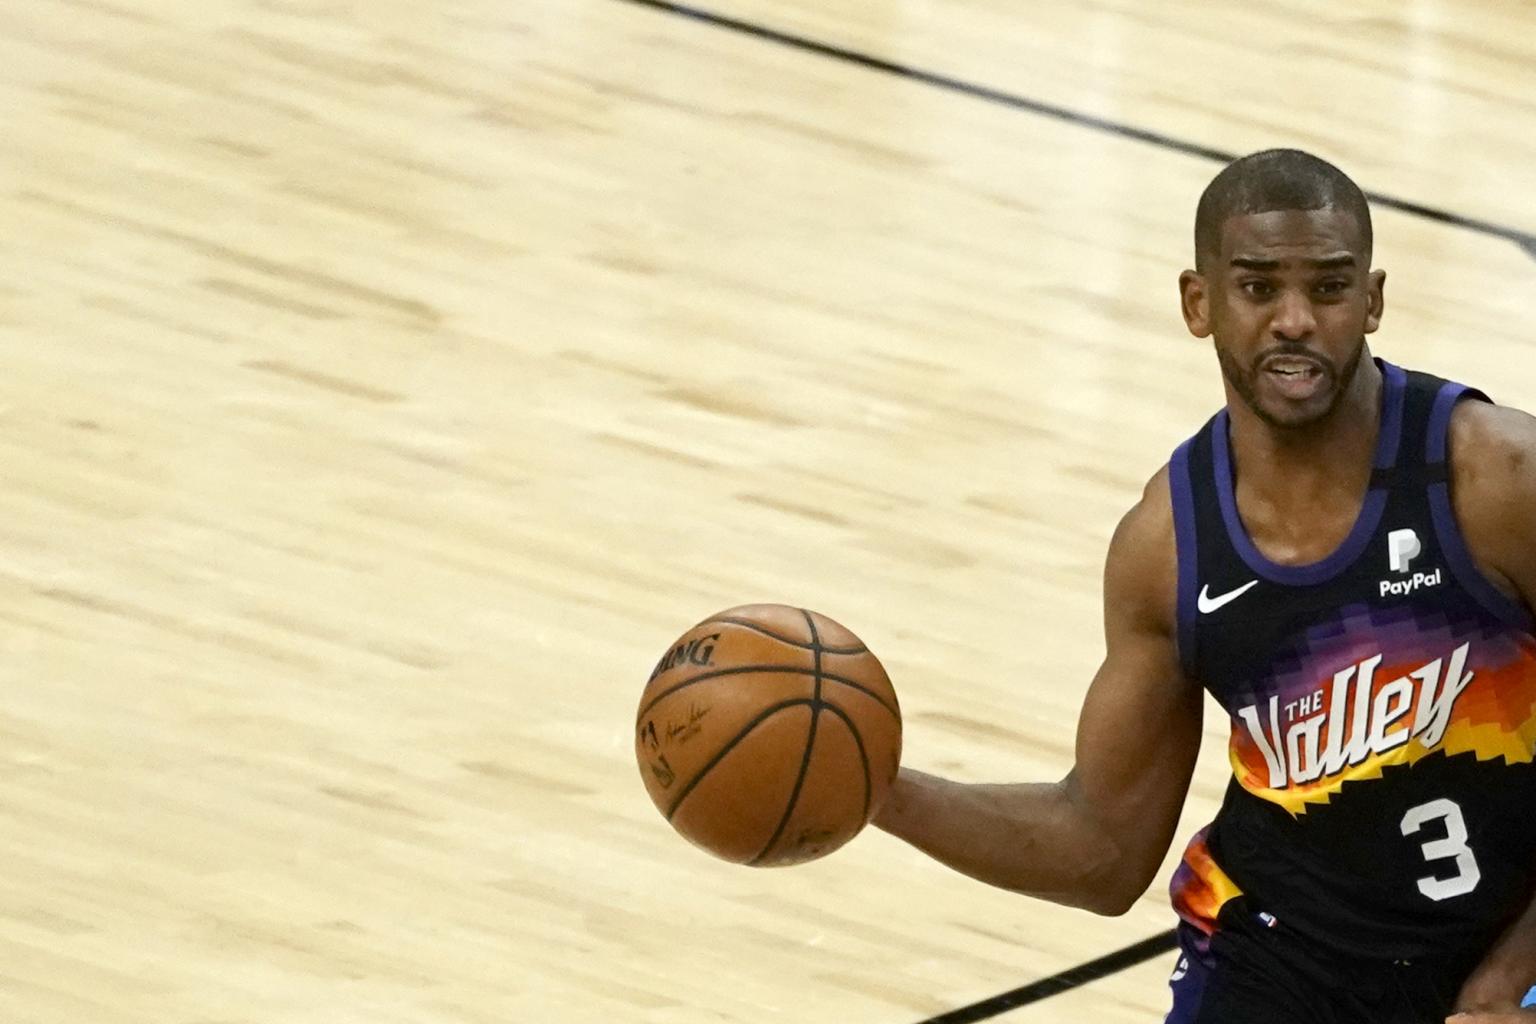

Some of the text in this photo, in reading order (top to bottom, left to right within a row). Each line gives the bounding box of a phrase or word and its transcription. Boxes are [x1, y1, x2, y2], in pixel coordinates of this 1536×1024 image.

[1379, 568, 1441, 597] PayPal
[1238, 641, 1474, 789] Valley
[1285, 689, 1324, 722] THE
[1401, 798, 1482, 901] 3
